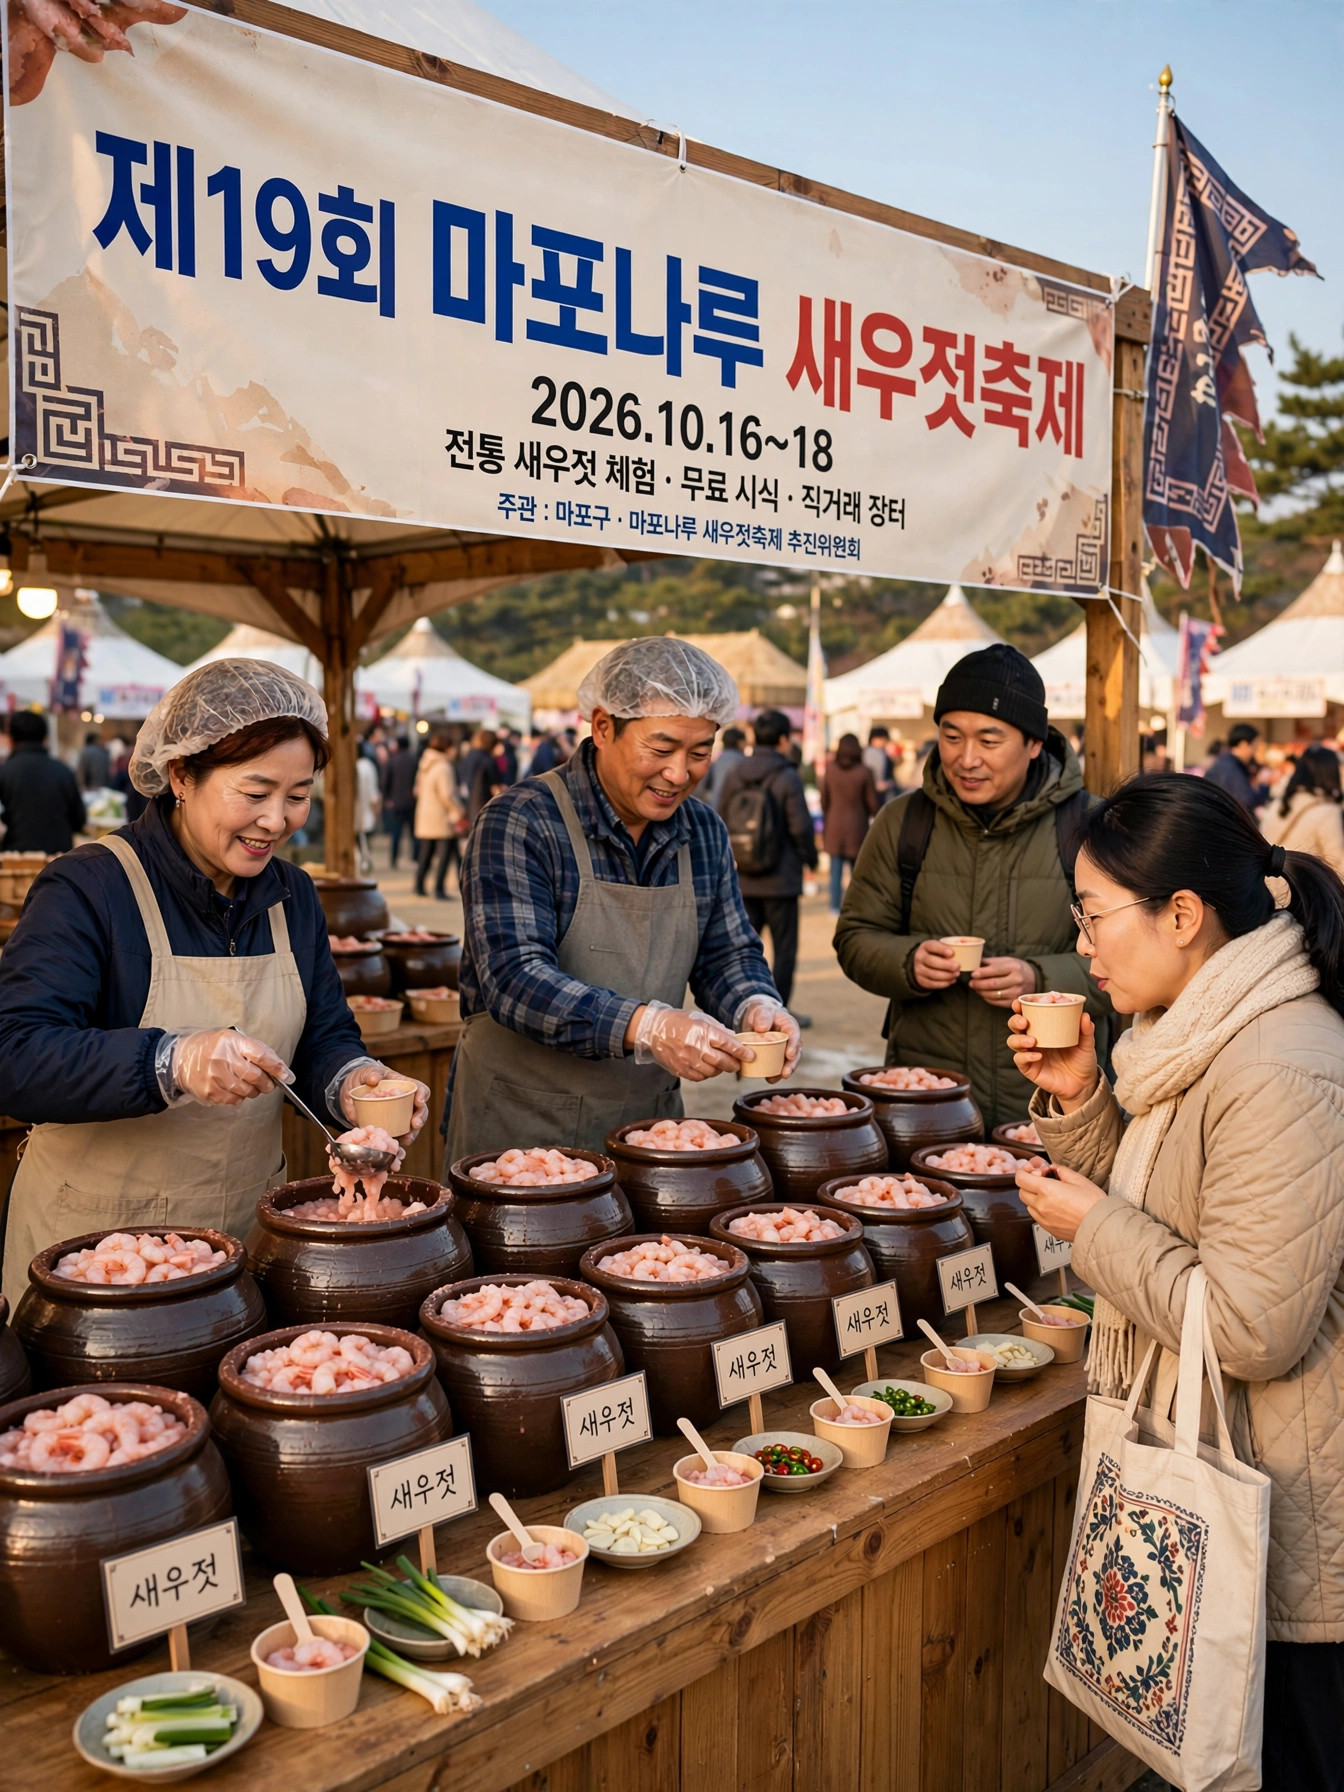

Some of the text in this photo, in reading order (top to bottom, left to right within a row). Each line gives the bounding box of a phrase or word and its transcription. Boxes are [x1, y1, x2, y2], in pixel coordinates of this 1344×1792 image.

[92, 130, 396, 319] 제19회
[432, 199, 764, 389] 마포나루
[786, 294, 1085, 459] 새우젓축제
[531, 375, 834, 473] 2026.10.16~18
[445, 428, 505, 475] 전통
[514, 440, 597, 488] 새우젓
[605, 454, 655, 496] 체험
[681, 465, 728, 503] 무료
[735, 474, 779, 513] 시식
[801, 484, 861, 524] 직거래
[868, 493, 905, 530] 장터
[497, 492, 537, 523] 주관
[556, 500, 611, 531] 마포구
[629, 510, 697, 541] 마포나루
[703, 519, 783, 552] 새우젓축제
[787, 529, 861, 561] 추진위원회
[1044, 1235, 1072, 1254] 새우
[950, 1262, 988, 1291] 새우젓
[847, 1301, 890, 1334] 새우젓
[729, 1343, 777, 1380] 새우젓
[580, 1397, 635, 1437] 새우젓
[390, 1464, 457, 1510] 새우젓
[130, 1552, 219, 1609] 새우젓
